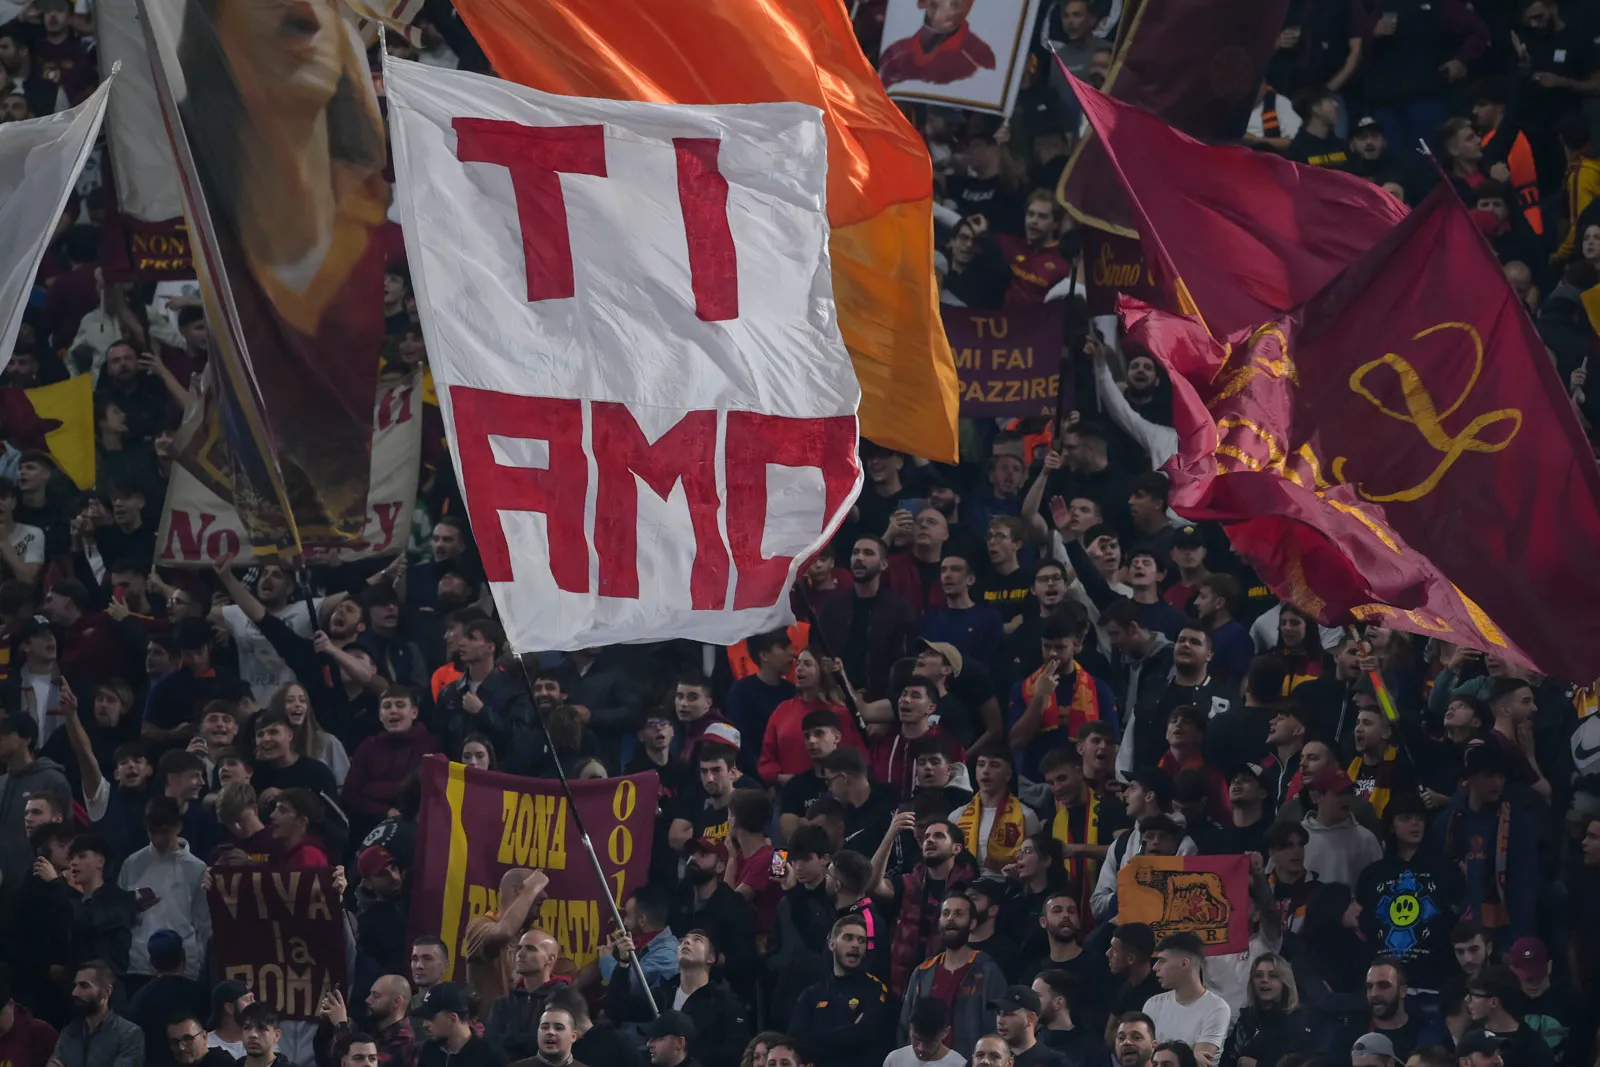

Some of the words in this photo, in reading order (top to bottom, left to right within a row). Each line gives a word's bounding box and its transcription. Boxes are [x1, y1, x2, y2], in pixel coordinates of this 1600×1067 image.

[452, 117, 739, 322] TI
[952, 347, 981, 370] MI
[991, 347, 1033, 370] FAI
[970, 316, 1008, 338] TU
[449, 385, 861, 612] AMO
[498, 790, 567, 870] ZONA
[214, 871, 333, 921] VIVA
